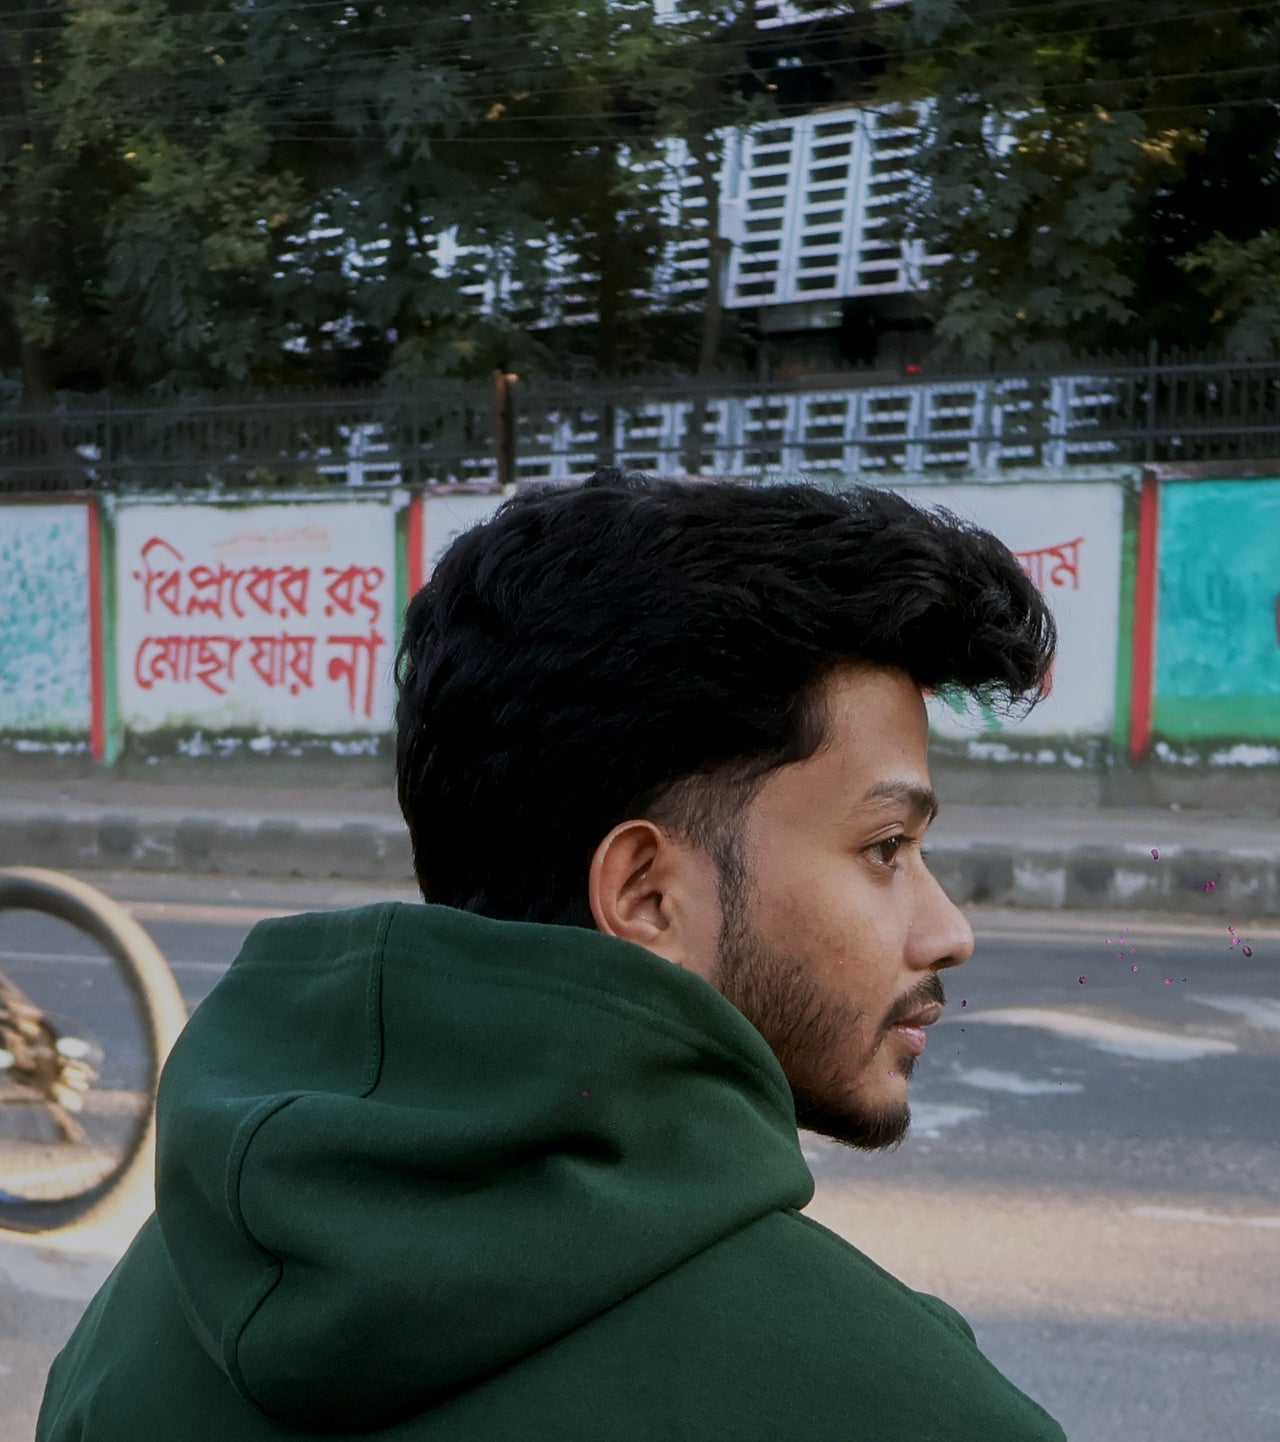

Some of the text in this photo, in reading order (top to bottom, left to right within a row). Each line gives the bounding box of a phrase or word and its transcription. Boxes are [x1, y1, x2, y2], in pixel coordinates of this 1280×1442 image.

[132, 536, 312, 620] বিপ্লবের
[135, 633, 243, 696] মোছা
[326, 629, 386, 719] না
